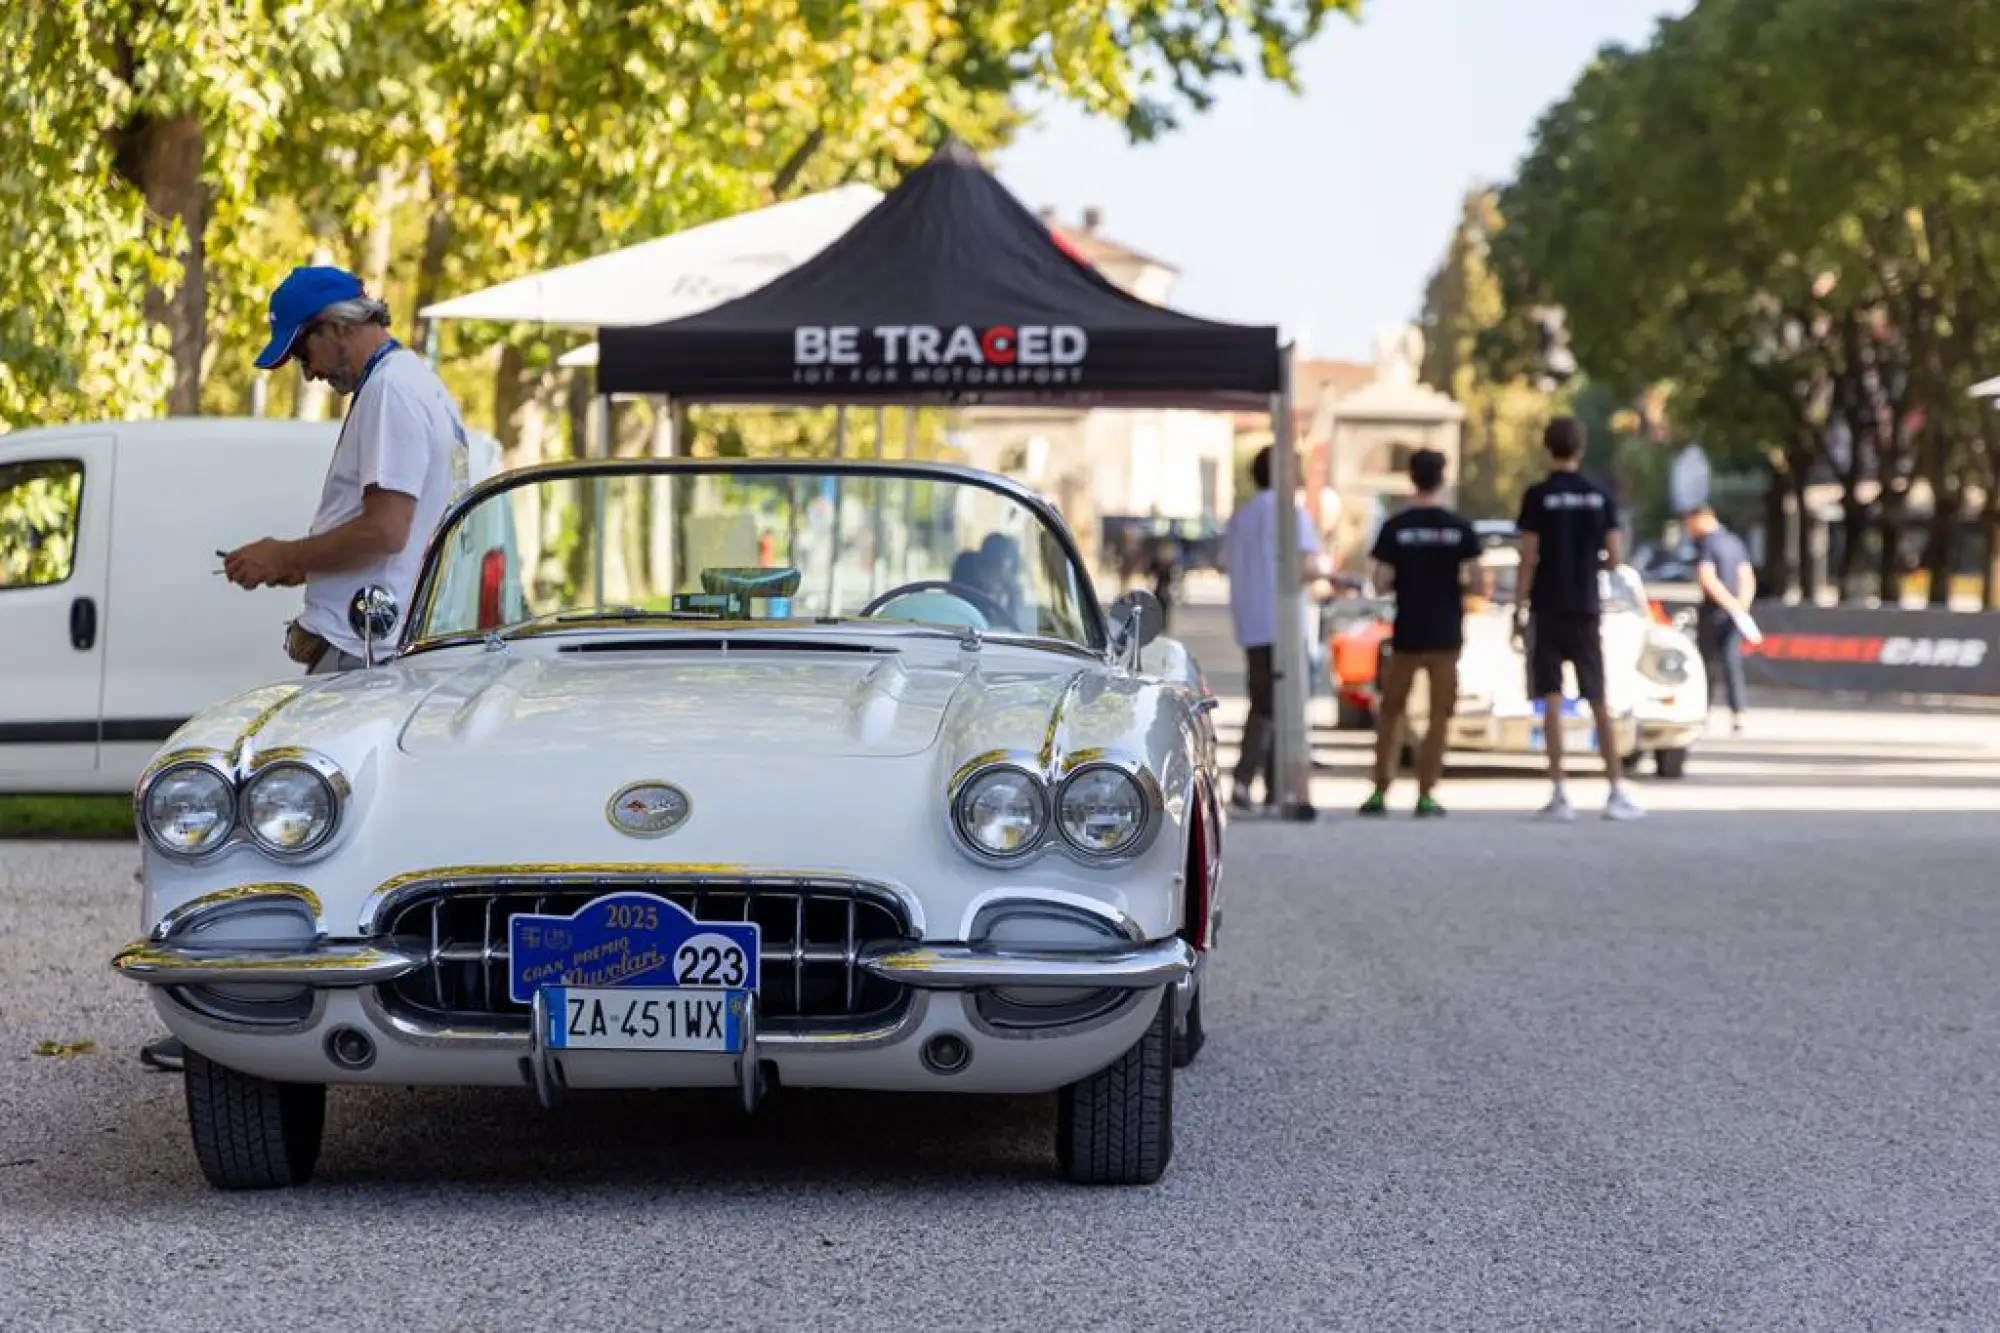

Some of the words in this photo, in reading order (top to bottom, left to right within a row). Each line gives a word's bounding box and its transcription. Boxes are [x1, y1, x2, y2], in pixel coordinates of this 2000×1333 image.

[794, 325, 861, 364] BE
[873, 324, 1088, 367] TRACED
[848, 367, 898, 384] FOR
[911, 366, 1084, 384] MOTORSPORT
[604, 905, 659, 930] 2025
[522, 959, 564, 983] GRAN
[573, 936, 631, 965] PREMIO
[678, 945, 744, 987] 223
